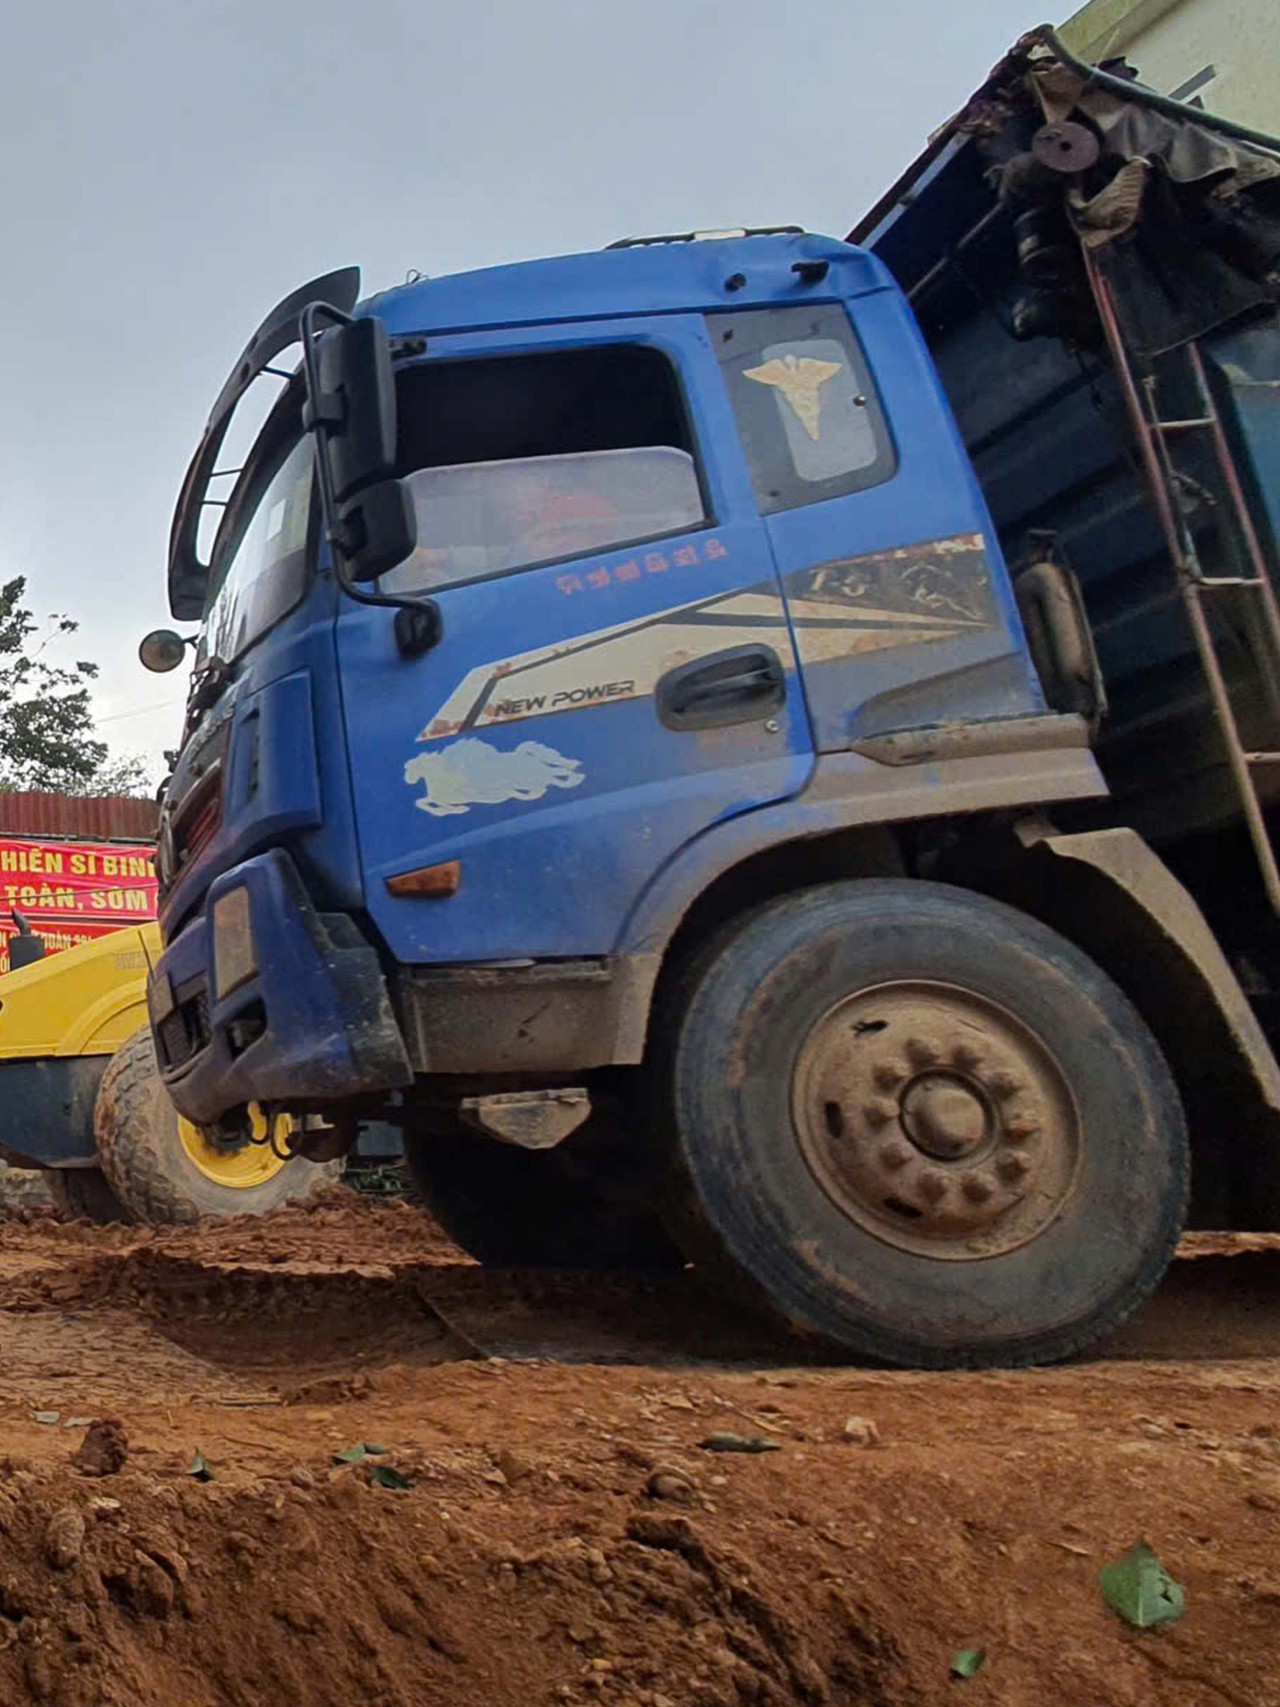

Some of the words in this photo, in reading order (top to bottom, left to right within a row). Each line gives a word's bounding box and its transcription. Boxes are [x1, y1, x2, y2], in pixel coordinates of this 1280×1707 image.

[496, 695, 547, 718] NEW
[552, 679, 636, 708] POWER
[4, 882, 84, 911] TOÀN,
